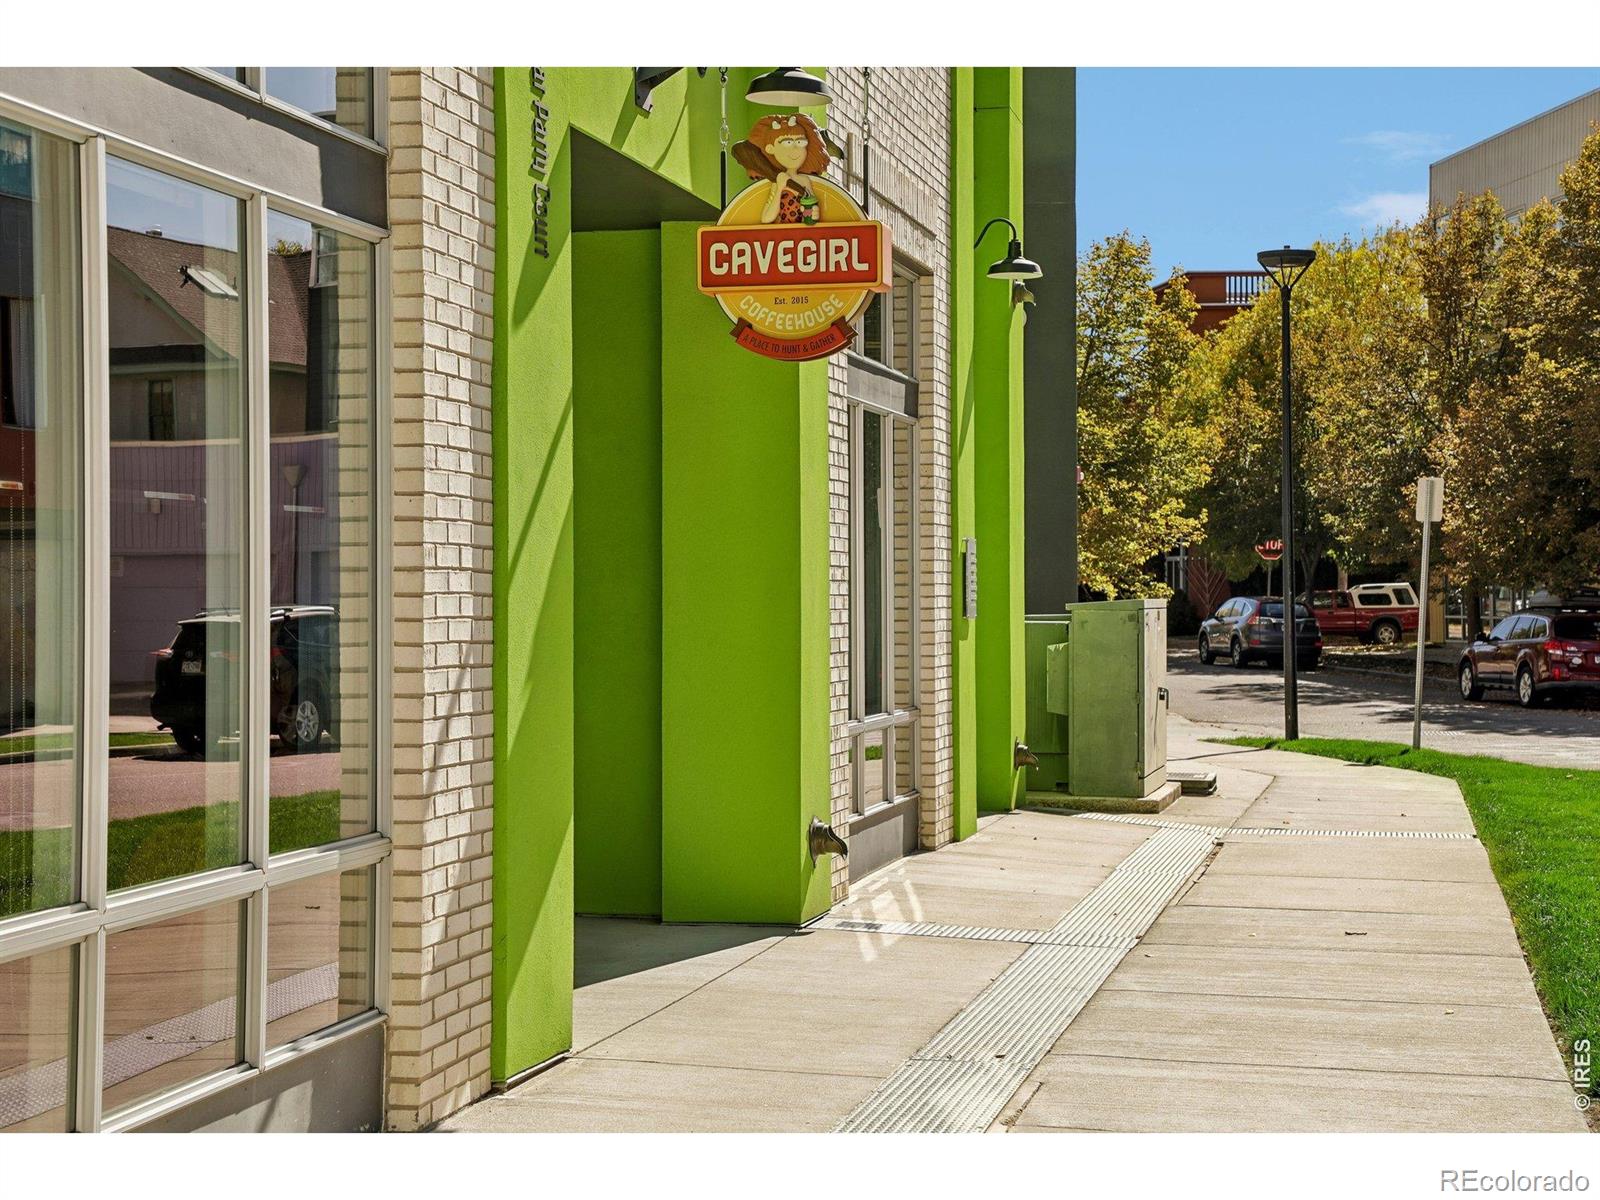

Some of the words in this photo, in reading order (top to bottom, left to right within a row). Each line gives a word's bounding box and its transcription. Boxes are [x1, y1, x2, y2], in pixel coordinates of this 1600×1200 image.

[532, 99, 549, 176] Party
[533, 183, 550, 260] Court
[709, 237, 870, 276] CAVEGIRL
[739, 293, 844, 330] COFFEEHOUSE
[774, 296, 788, 305] Est.
[791, 295, 809, 305] 2015
[743, 334, 750, 342] A
[751, 336, 769, 352] PLACE
[771, 343, 780, 353] TO
[781, 344, 800, 354] HUNT
[802, 344, 809, 352] &
[809, 333, 836, 351] GATHER
